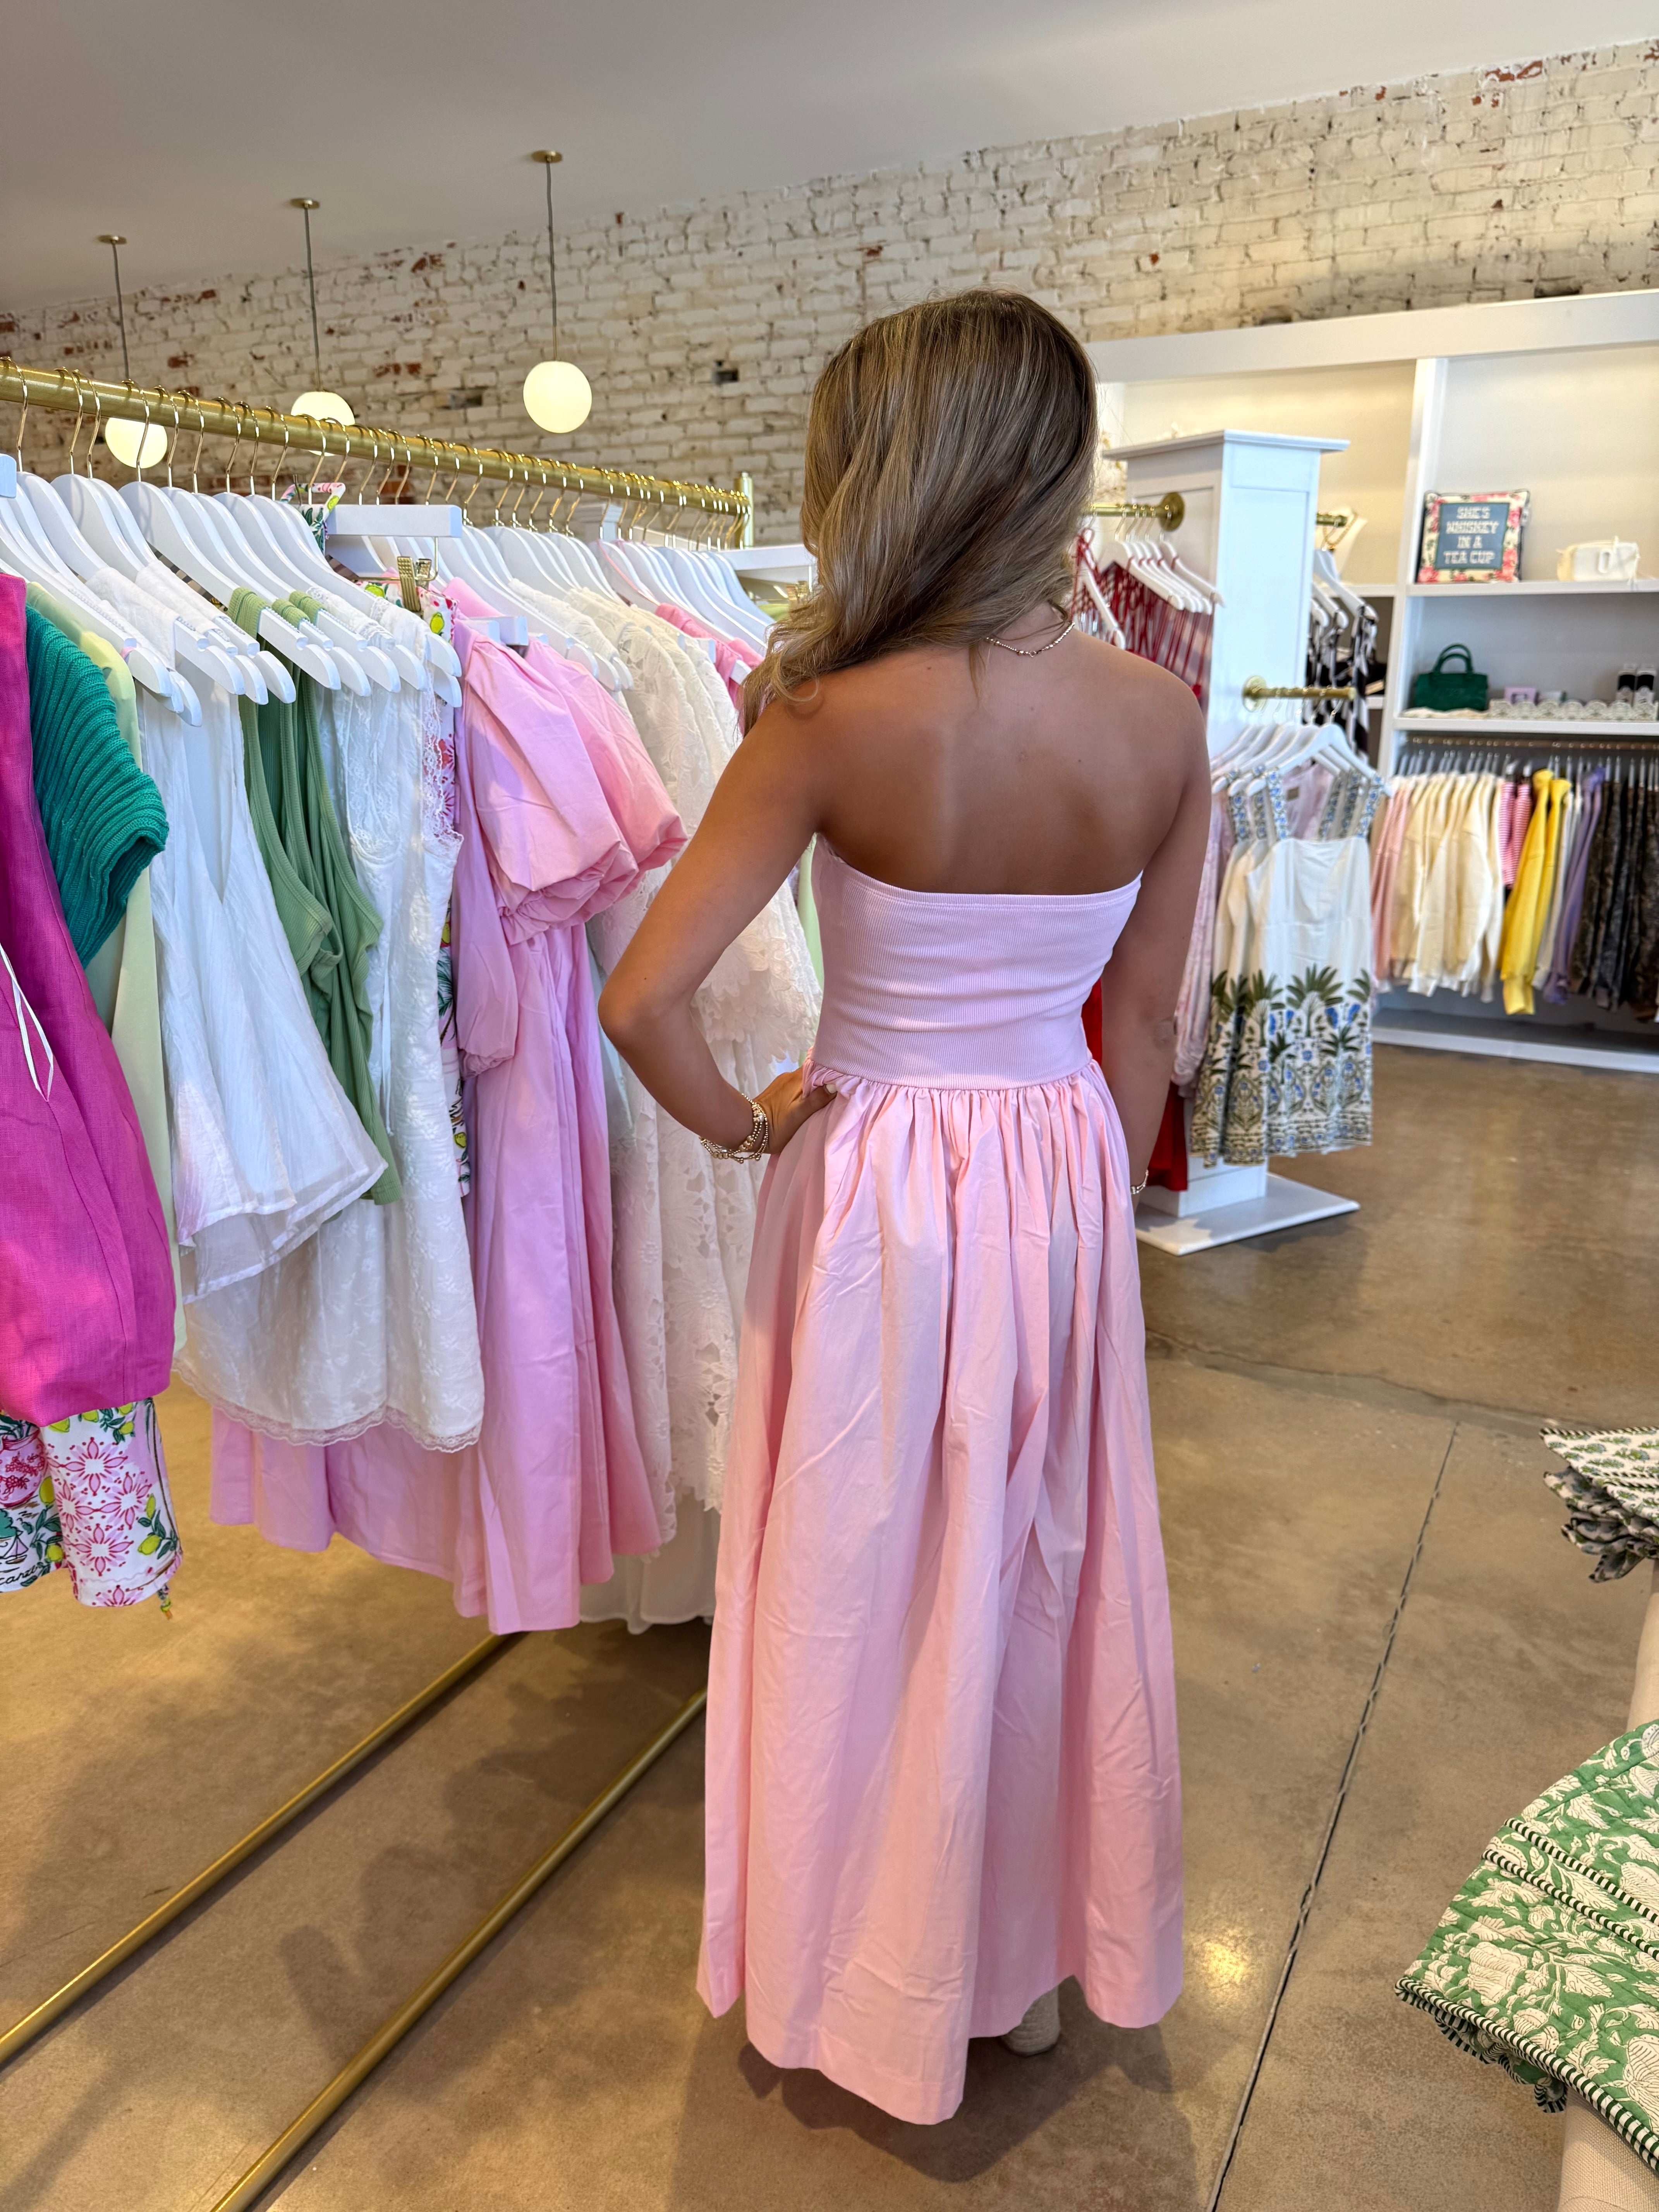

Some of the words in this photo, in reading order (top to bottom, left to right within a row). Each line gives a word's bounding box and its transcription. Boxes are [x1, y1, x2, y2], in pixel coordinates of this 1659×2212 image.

[1457, 507, 1491, 519] SHE'S
[1446, 520, 1499, 534] WHISKEY
[1458, 536, 1471, 548] IN
[1473, 536, 1482, 548] A
[1444, 551, 1467, 564] TEA
[1470, 551, 1495, 564] CUP
